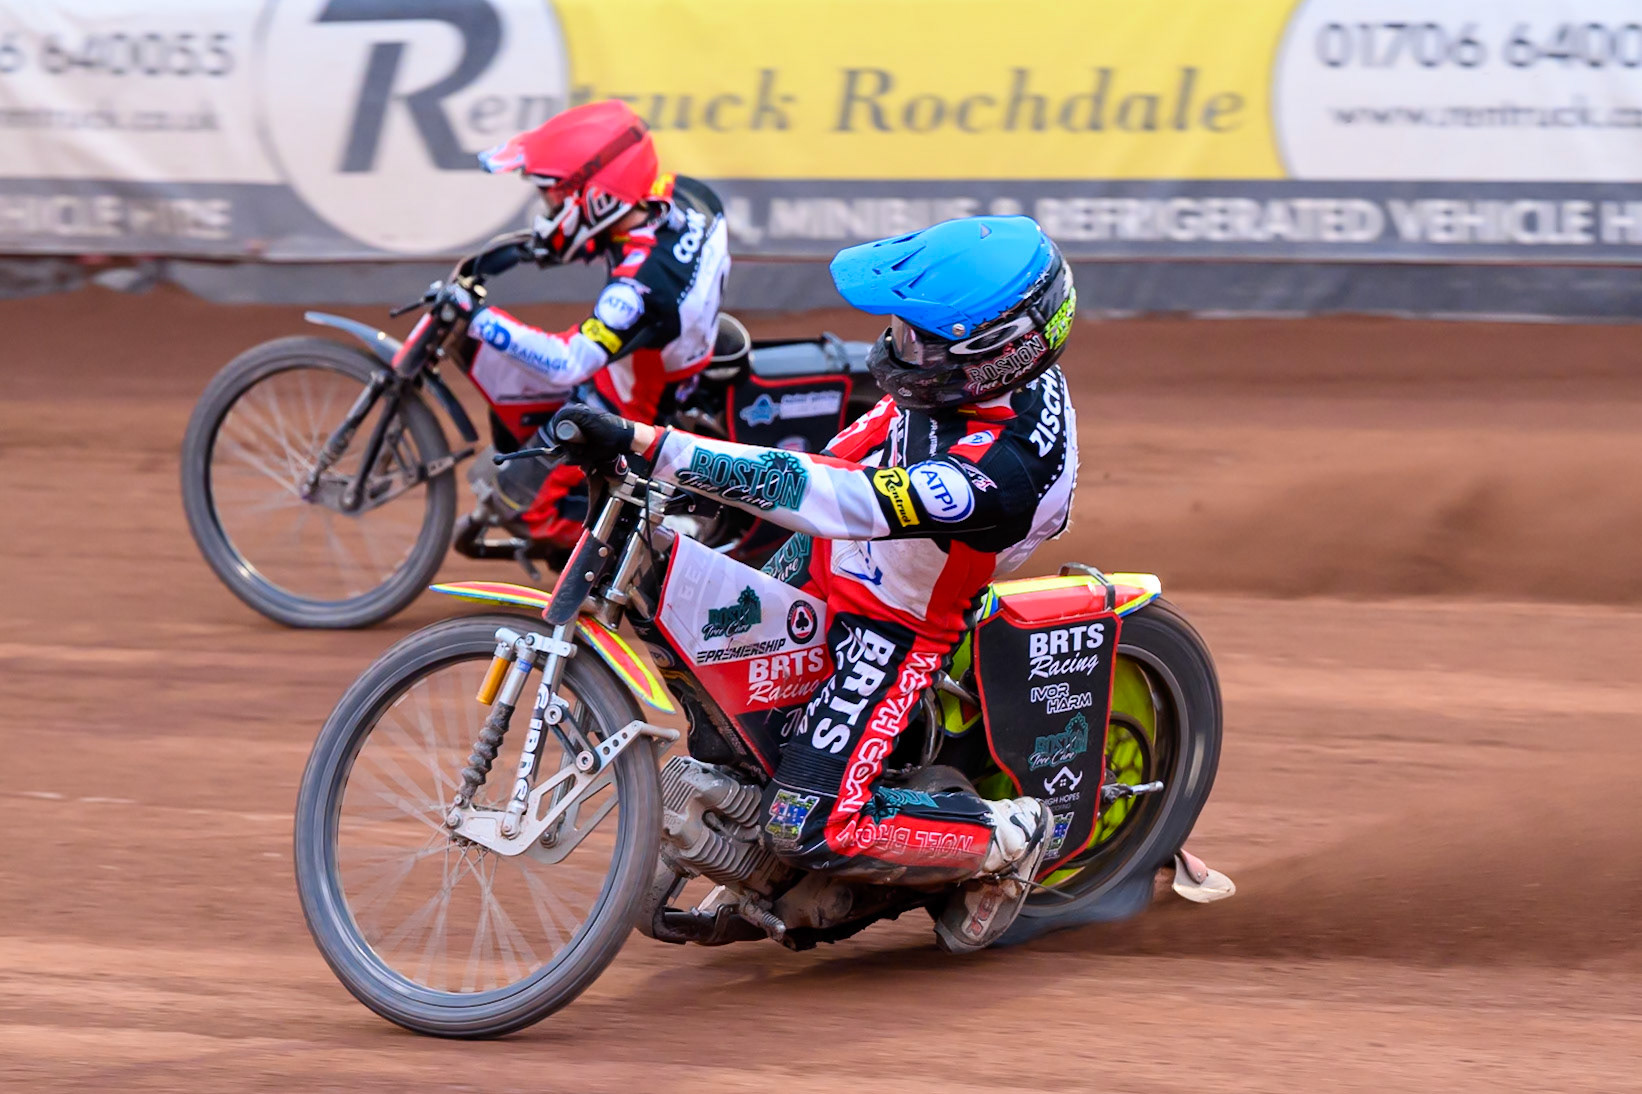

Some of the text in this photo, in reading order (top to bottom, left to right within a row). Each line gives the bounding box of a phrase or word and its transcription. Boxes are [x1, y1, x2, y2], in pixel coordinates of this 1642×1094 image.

[38, 32, 237, 76] 640055
[1315, 22, 1488, 69] 01706
[829, 66, 1247, 134] Rochdale
[1035, 198, 1384, 241] REFRIGERATED
[1386, 199, 1597, 244] VEHICLE
[968, 334, 1047, 384] BOSTON
[677, 469, 775, 510] Tree Care
[690, 446, 807, 511] BOSTON
[921, 469, 958, 512] ATPI
[1029, 622, 1105, 659] BRTS
[748, 647, 824, 684] BRTS
[1028, 653, 1100, 681] Racing
[811, 626, 897, 755] BRTS
[1030, 682, 1070, 703] IVOR
[1046, 691, 1093, 715] HARM
[1059, 791, 1081, 803] HOPES
